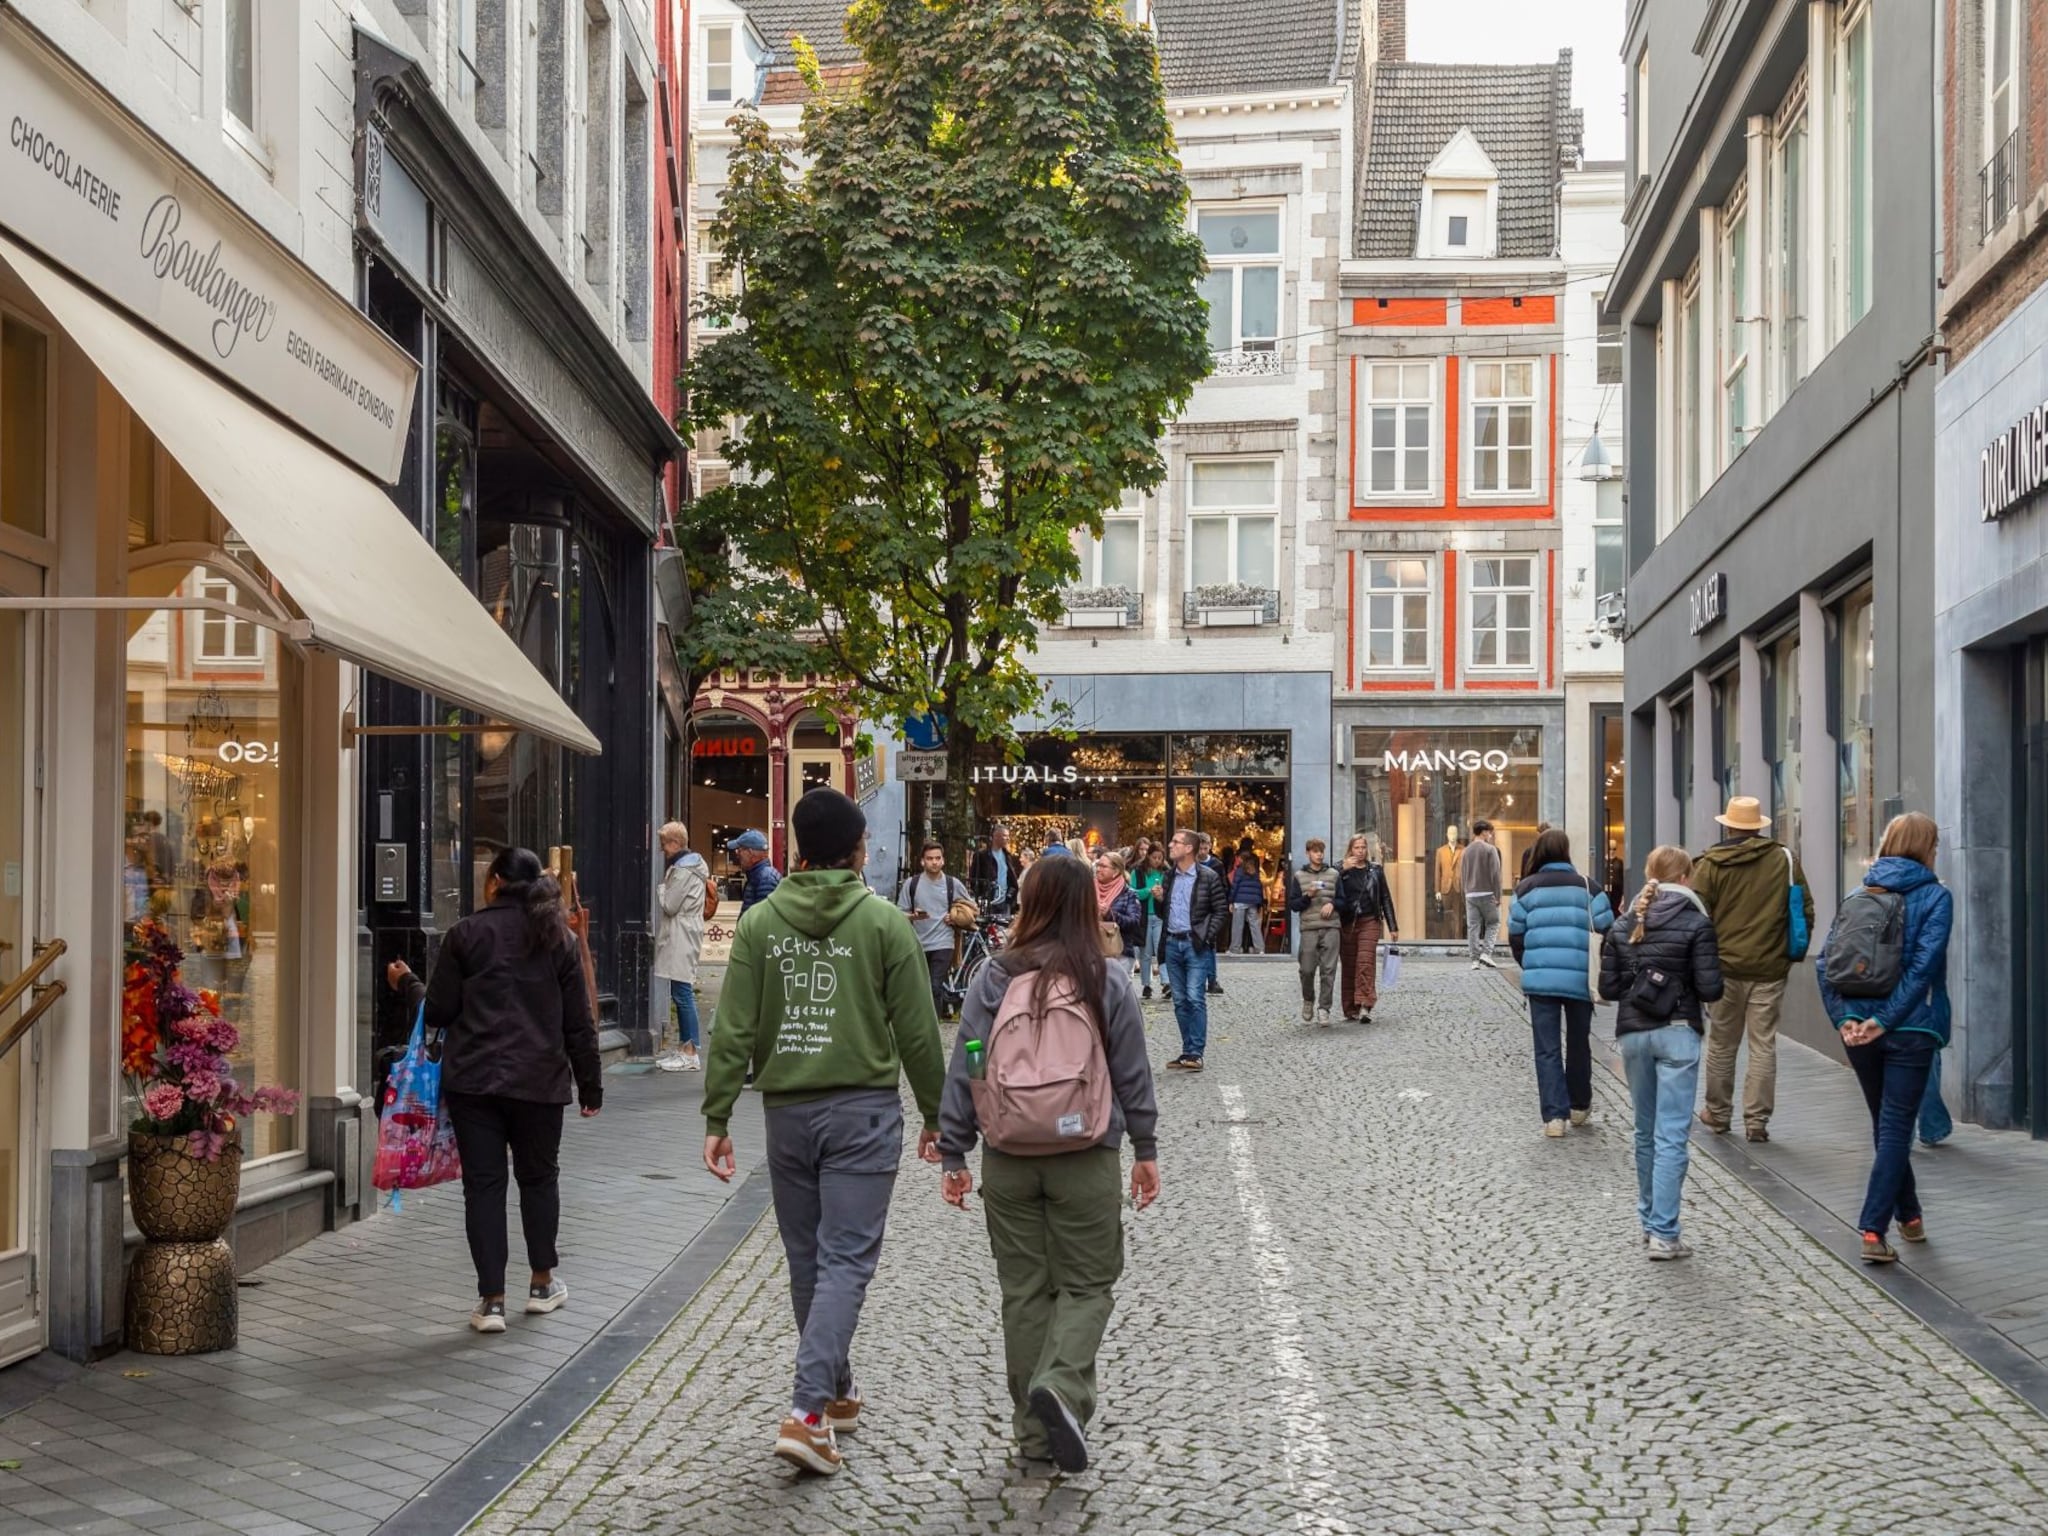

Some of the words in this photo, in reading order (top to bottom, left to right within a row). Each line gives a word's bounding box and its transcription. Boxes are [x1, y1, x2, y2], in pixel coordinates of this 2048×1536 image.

[11, 115, 121, 222] CHOCOLATERIE
[141, 194, 277, 359] Boulanger
[286, 330, 314, 368] EIGEN
[314, 351, 359, 401] FABRIKAAT
[358, 384, 394, 429] BONBONS
[973, 765, 1118, 783] ITUALS...
[1384, 749, 1508, 772] MANGO
[826, 936, 853, 957] Jack
